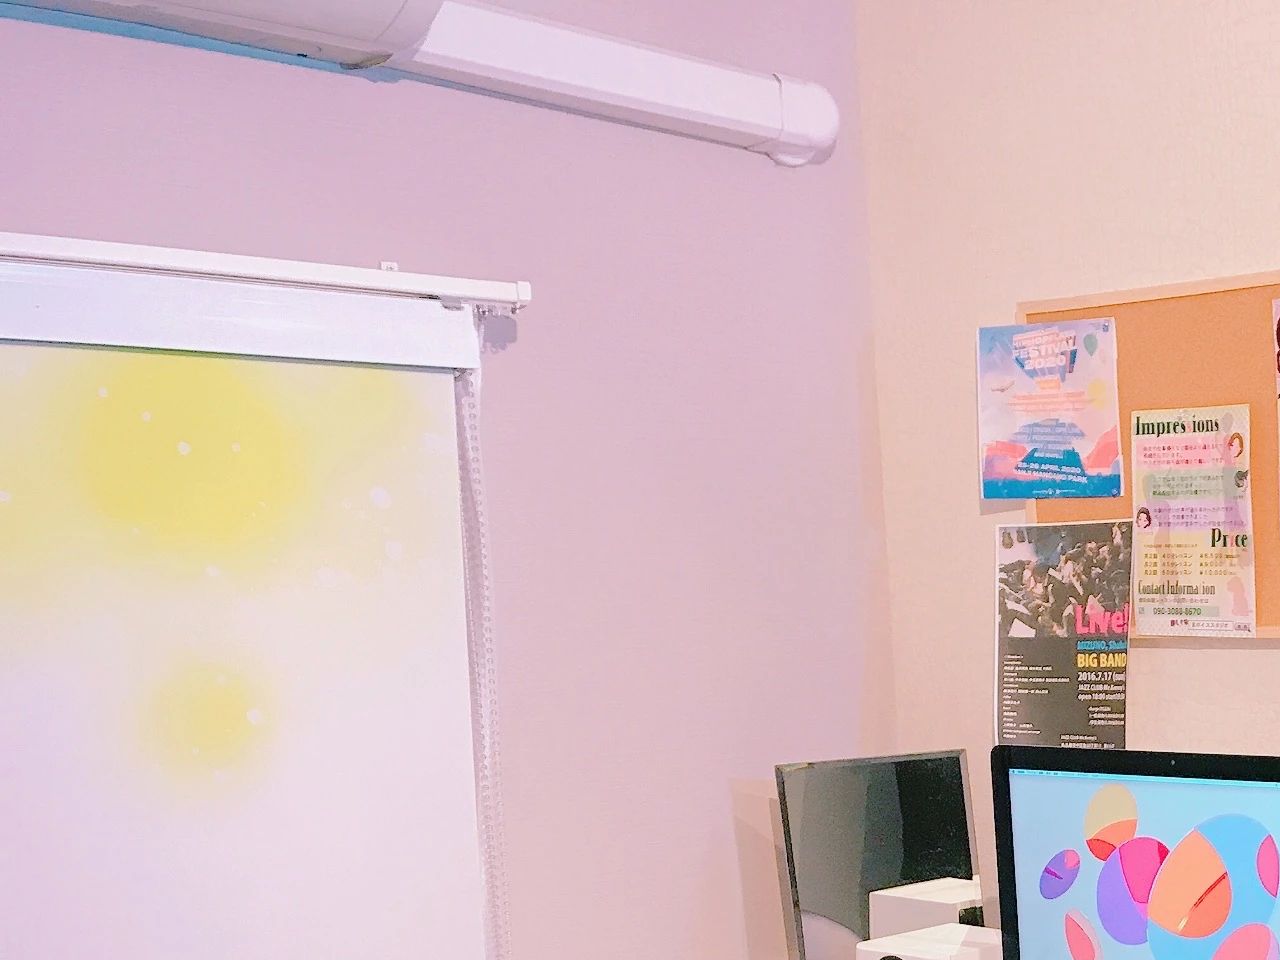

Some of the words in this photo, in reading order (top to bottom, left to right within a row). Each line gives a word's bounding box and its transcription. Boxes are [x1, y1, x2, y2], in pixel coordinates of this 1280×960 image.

[1074, 602, 1131, 634] Live!
[1077, 653, 1098, 668] BIG
[1099, 652, 1127, 668] BAND
